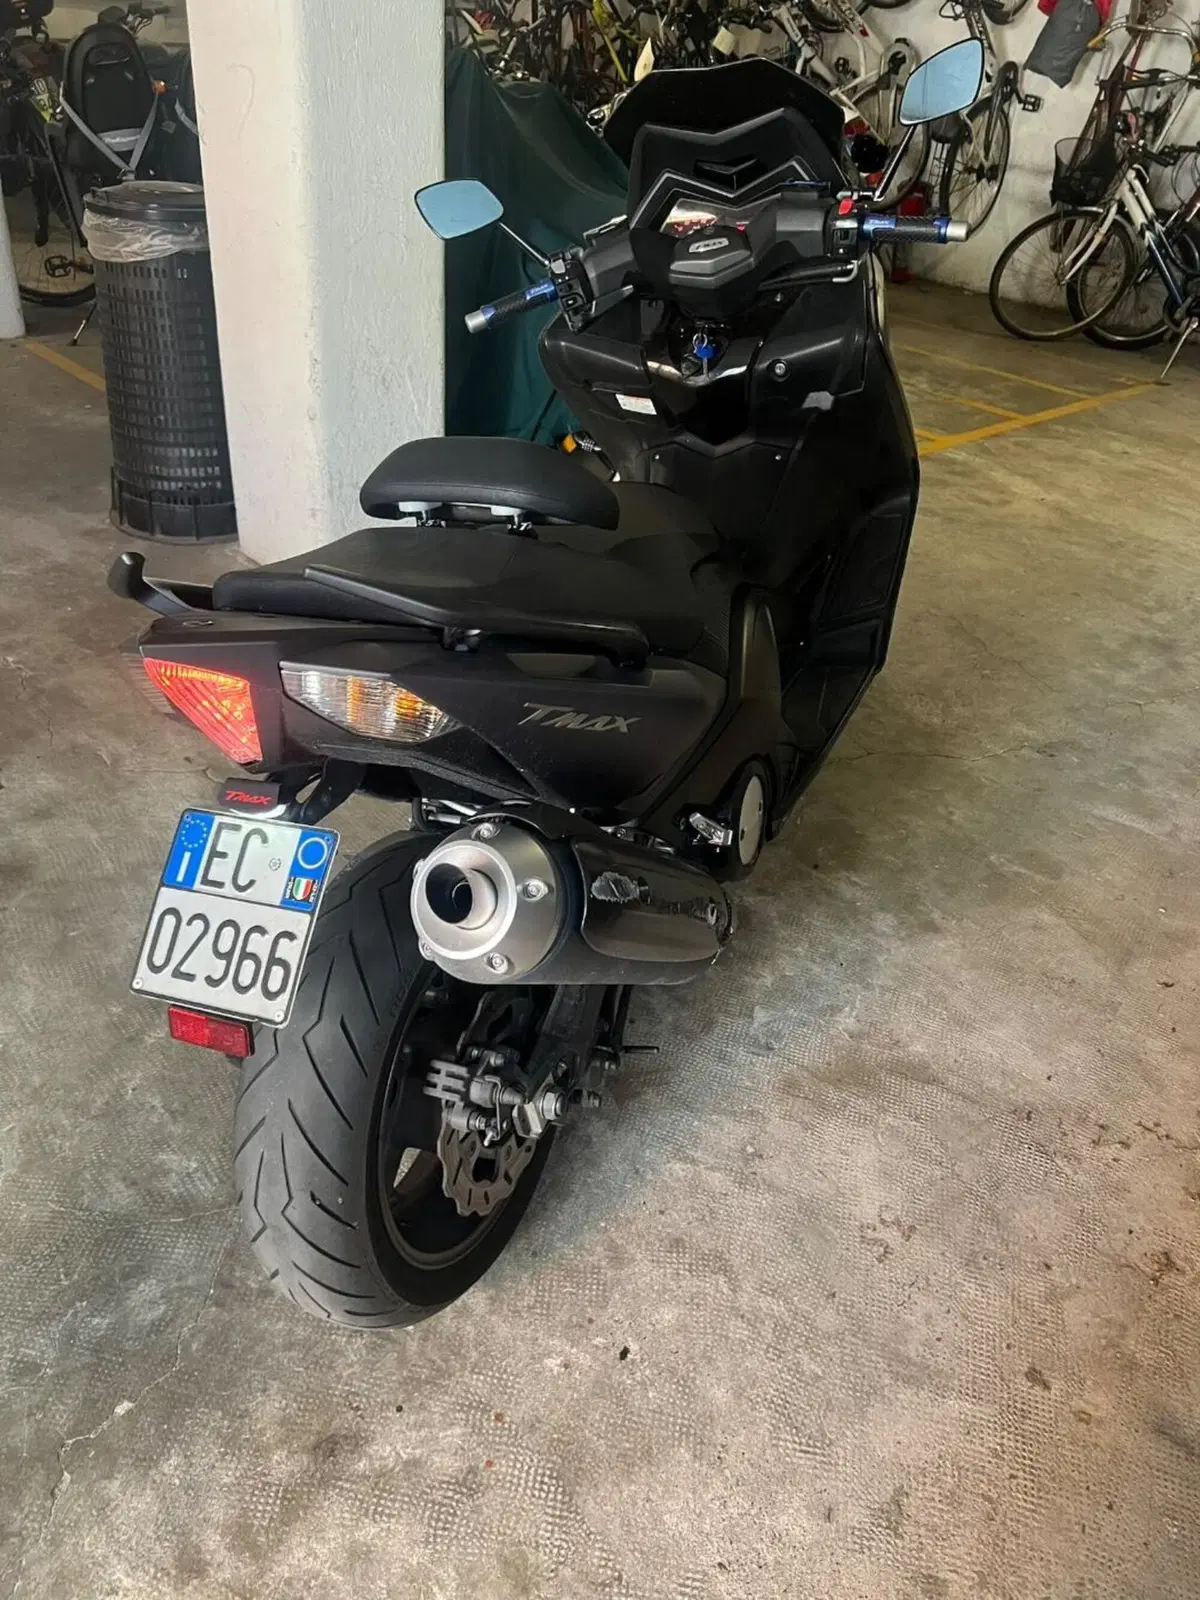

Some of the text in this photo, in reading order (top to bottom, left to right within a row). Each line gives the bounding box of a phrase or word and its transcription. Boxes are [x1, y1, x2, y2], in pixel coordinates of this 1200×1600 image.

[176, 851, 191, 882] I
[200, 821, 268, 893] EC
[146, 907, 298, 1001] 02966
